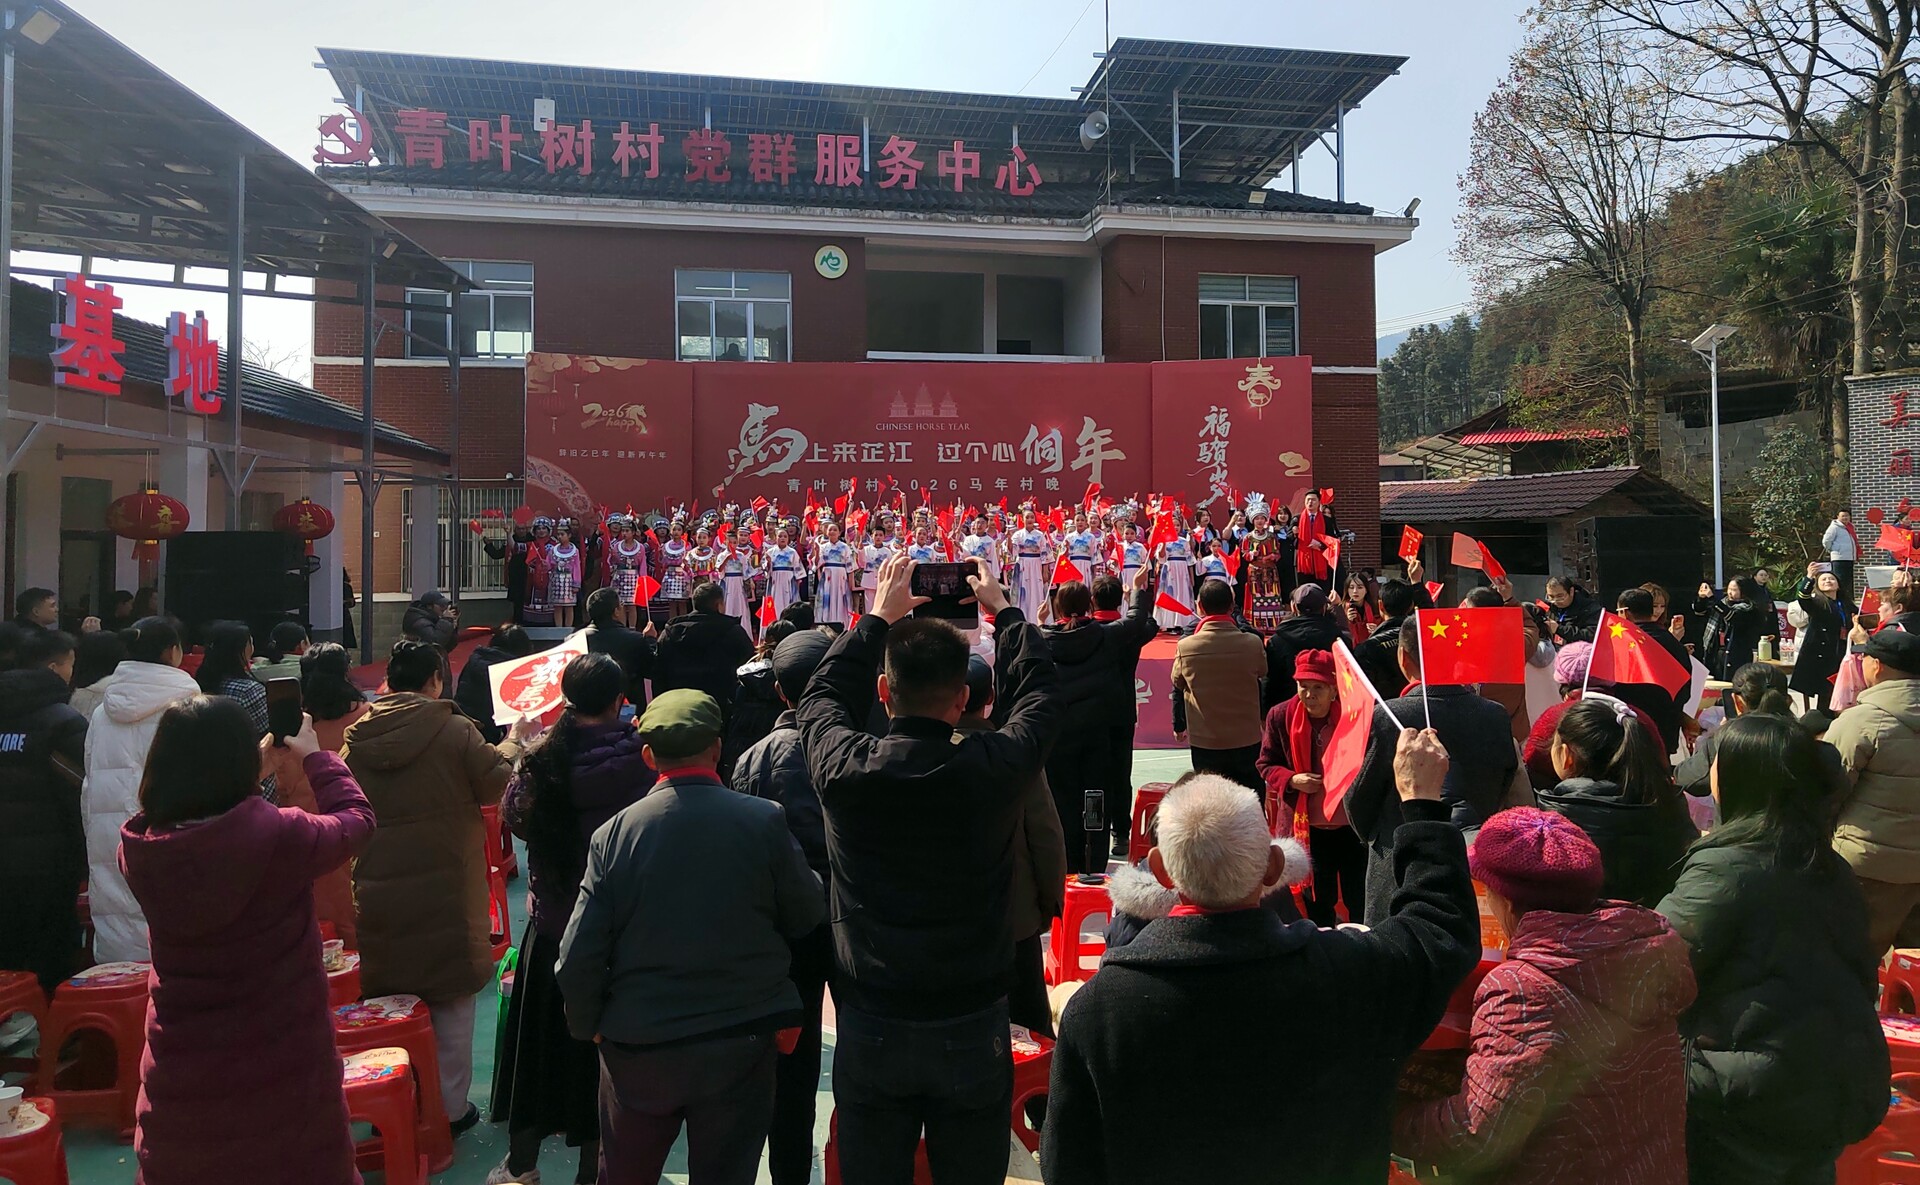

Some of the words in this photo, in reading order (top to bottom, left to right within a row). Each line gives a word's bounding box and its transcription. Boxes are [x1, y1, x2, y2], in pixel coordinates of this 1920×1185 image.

[394, 107, 1043, 197] 青叶树村党群服务中心
[51, 273, 222, 415] 基地
[581, 402, 632, 429] 2026
[875, 423, 914, 431] CHINESE
[916, 423, 945, 431] HORSE
[948, 423, 971, 431] YEAR
